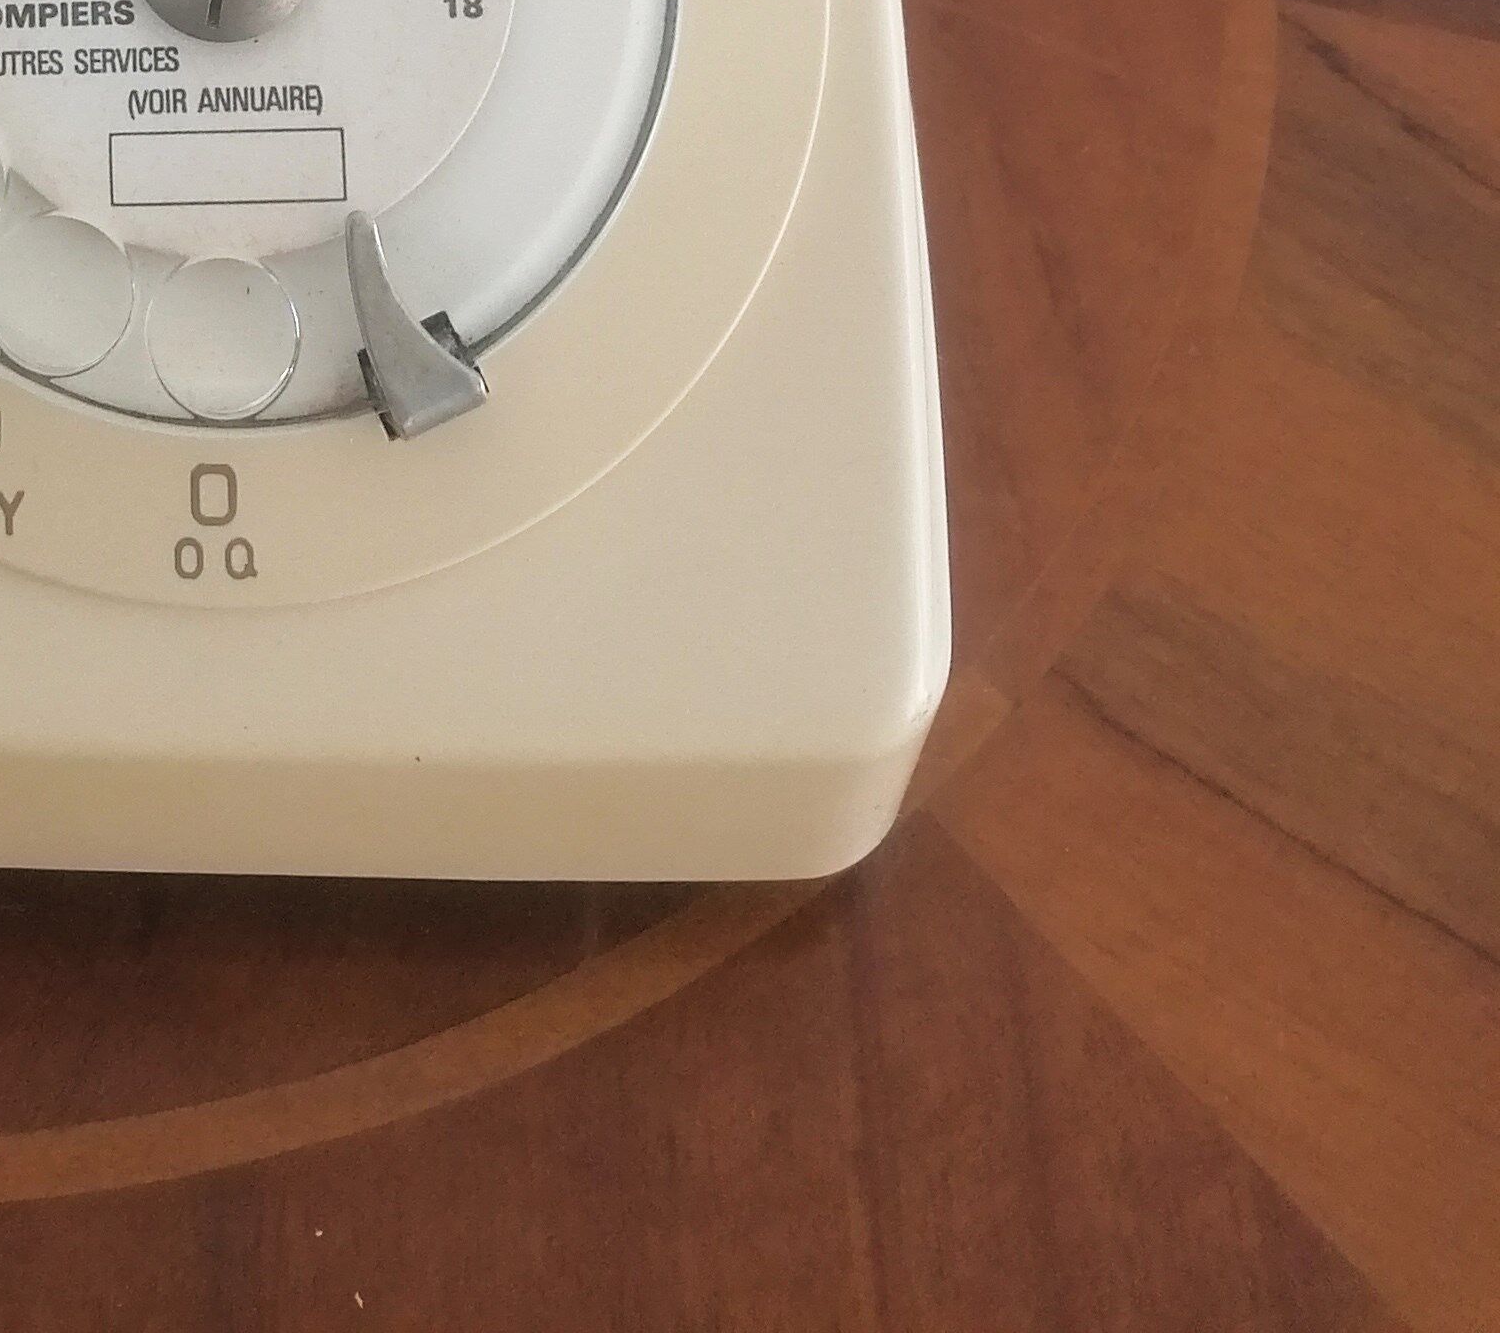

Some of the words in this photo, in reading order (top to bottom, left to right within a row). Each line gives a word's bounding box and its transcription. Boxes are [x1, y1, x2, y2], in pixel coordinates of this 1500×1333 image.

[73, 46, 180, 75] SERVICES
[128, 88, 188, 120] (VOIR
[197, 84, 324, 117] ANNUAIRE)
[190, 463, 237, 526] 0
